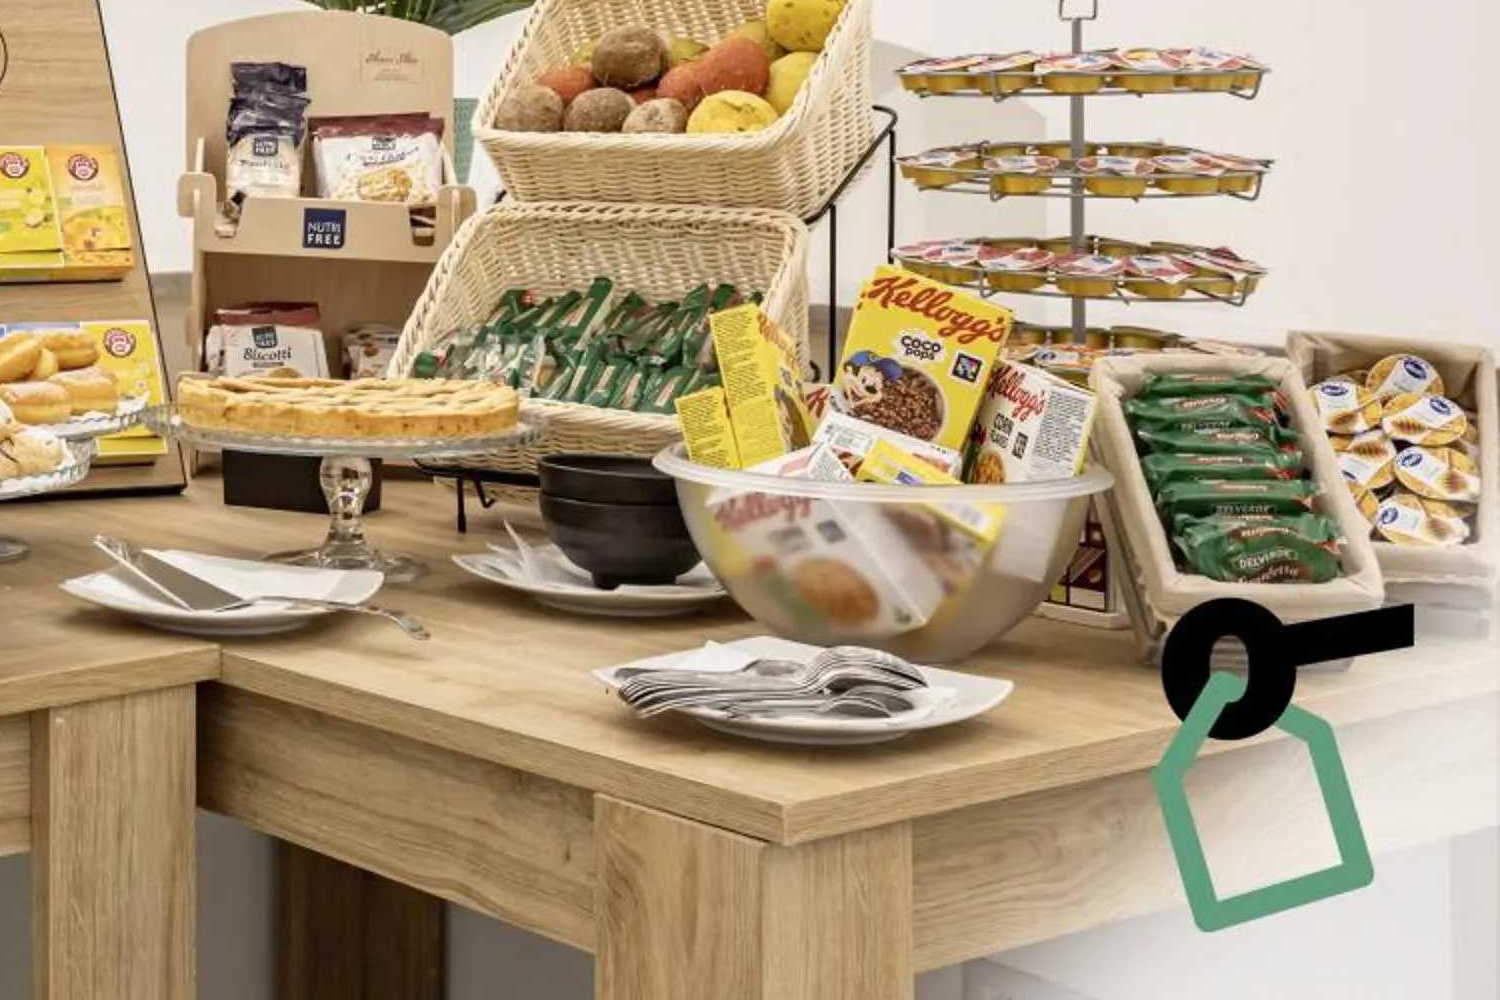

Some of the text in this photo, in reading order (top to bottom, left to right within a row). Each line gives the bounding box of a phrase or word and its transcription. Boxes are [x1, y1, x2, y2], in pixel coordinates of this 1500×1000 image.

[307, 233, 341, 245] FREE
[868, 275, 1005, 345] Kellogg's
[901, 335, 942, 353] COCO
[243, 346, 293, 361] Biscotti
[987, 363, 1046, 422] Kellogg's
